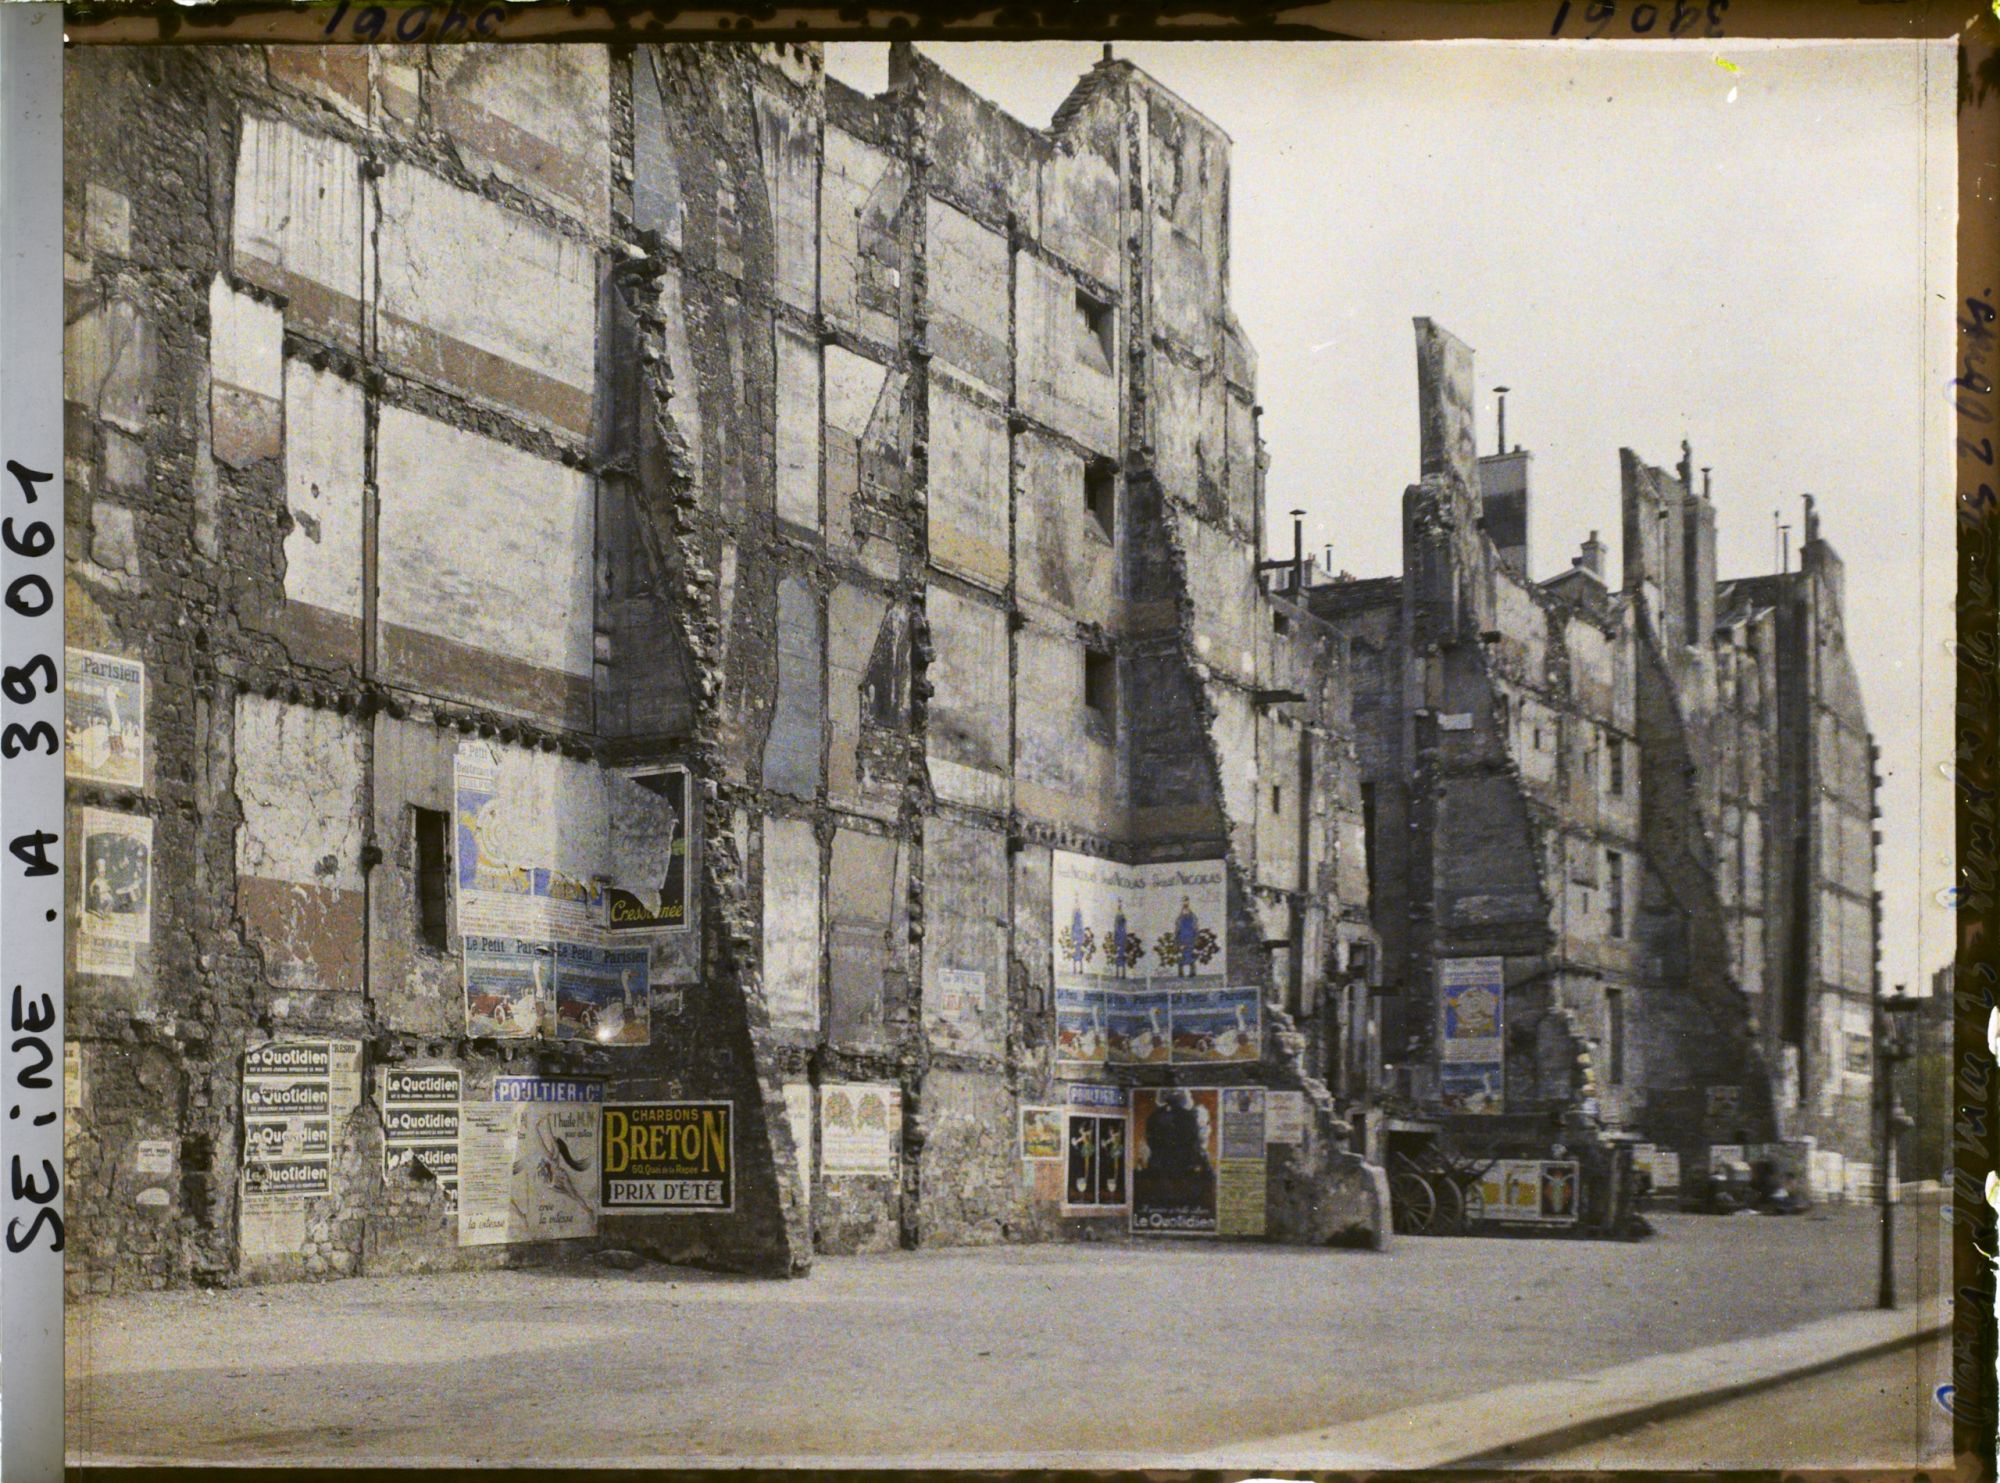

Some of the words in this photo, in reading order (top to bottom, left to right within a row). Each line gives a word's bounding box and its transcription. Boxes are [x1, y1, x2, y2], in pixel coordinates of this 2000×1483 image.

[82, 656, 140, 683] Parisien
[466, 936, 478, 951] Le
[482, 938, 505, 953] Petit
[262, 1049, 328, 1066] Quotidien
[388, 1077, 400, 1091] Le
[401, 1076, 458, 1092] Quotidien
[499, 1081, 577, 1102] POULTIER
[247, 1088, 261, 1104] Le
[262, 1088, 328, 1105] Quotidien
[387, 1114, 400, 1129] Le
[400, 1113, 458, 1130] Quotidien
[632, 1109, 699, 1121] CHARBONS
[604, 1110, 727, 1173] BRETON
[614, 1183, 656, 1200] PRIX
[664, 1181, 717, 1201] D'ÉTÉ
